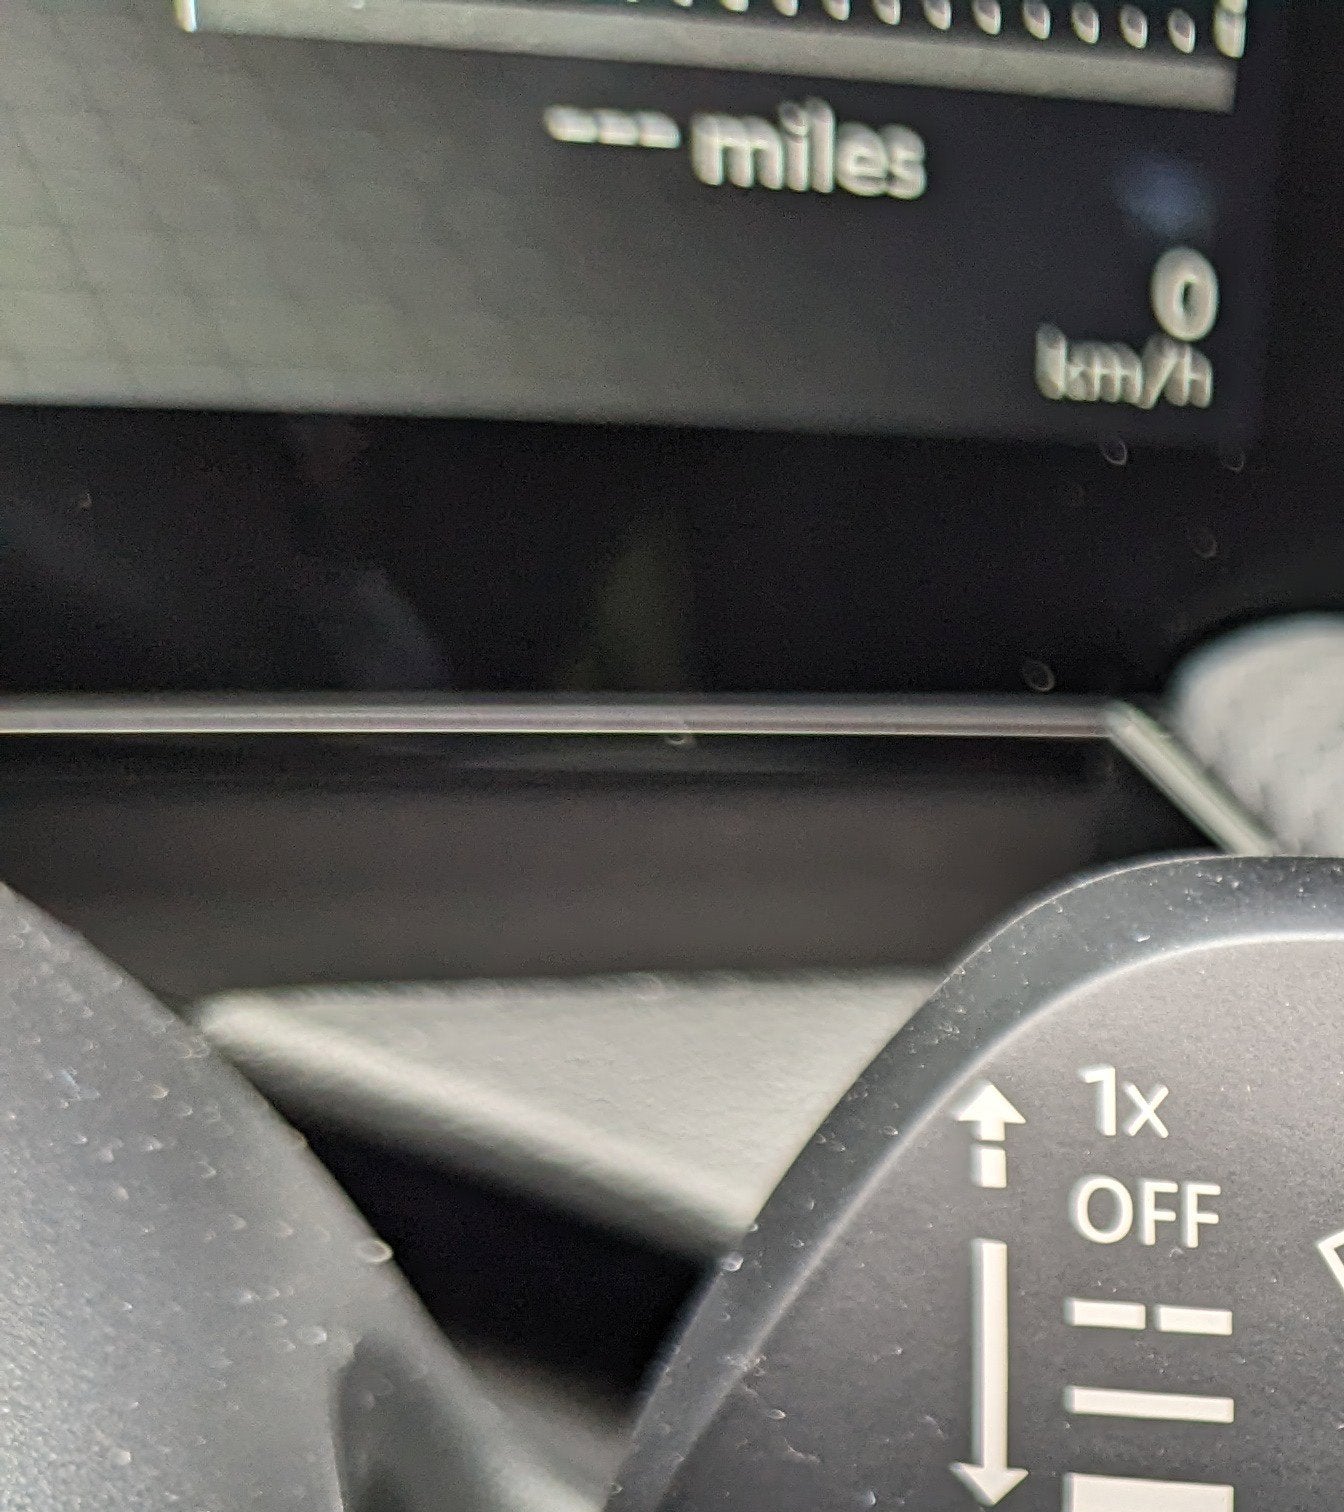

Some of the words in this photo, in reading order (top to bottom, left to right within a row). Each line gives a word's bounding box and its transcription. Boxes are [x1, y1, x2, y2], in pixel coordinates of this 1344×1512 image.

[691, 96, 928, 200] miles
[1035, 321, 1214, 410] km/h
[1083, 1064, 1170, 1139] 1x
[1071, 1175, 1222, 1250] OFF
